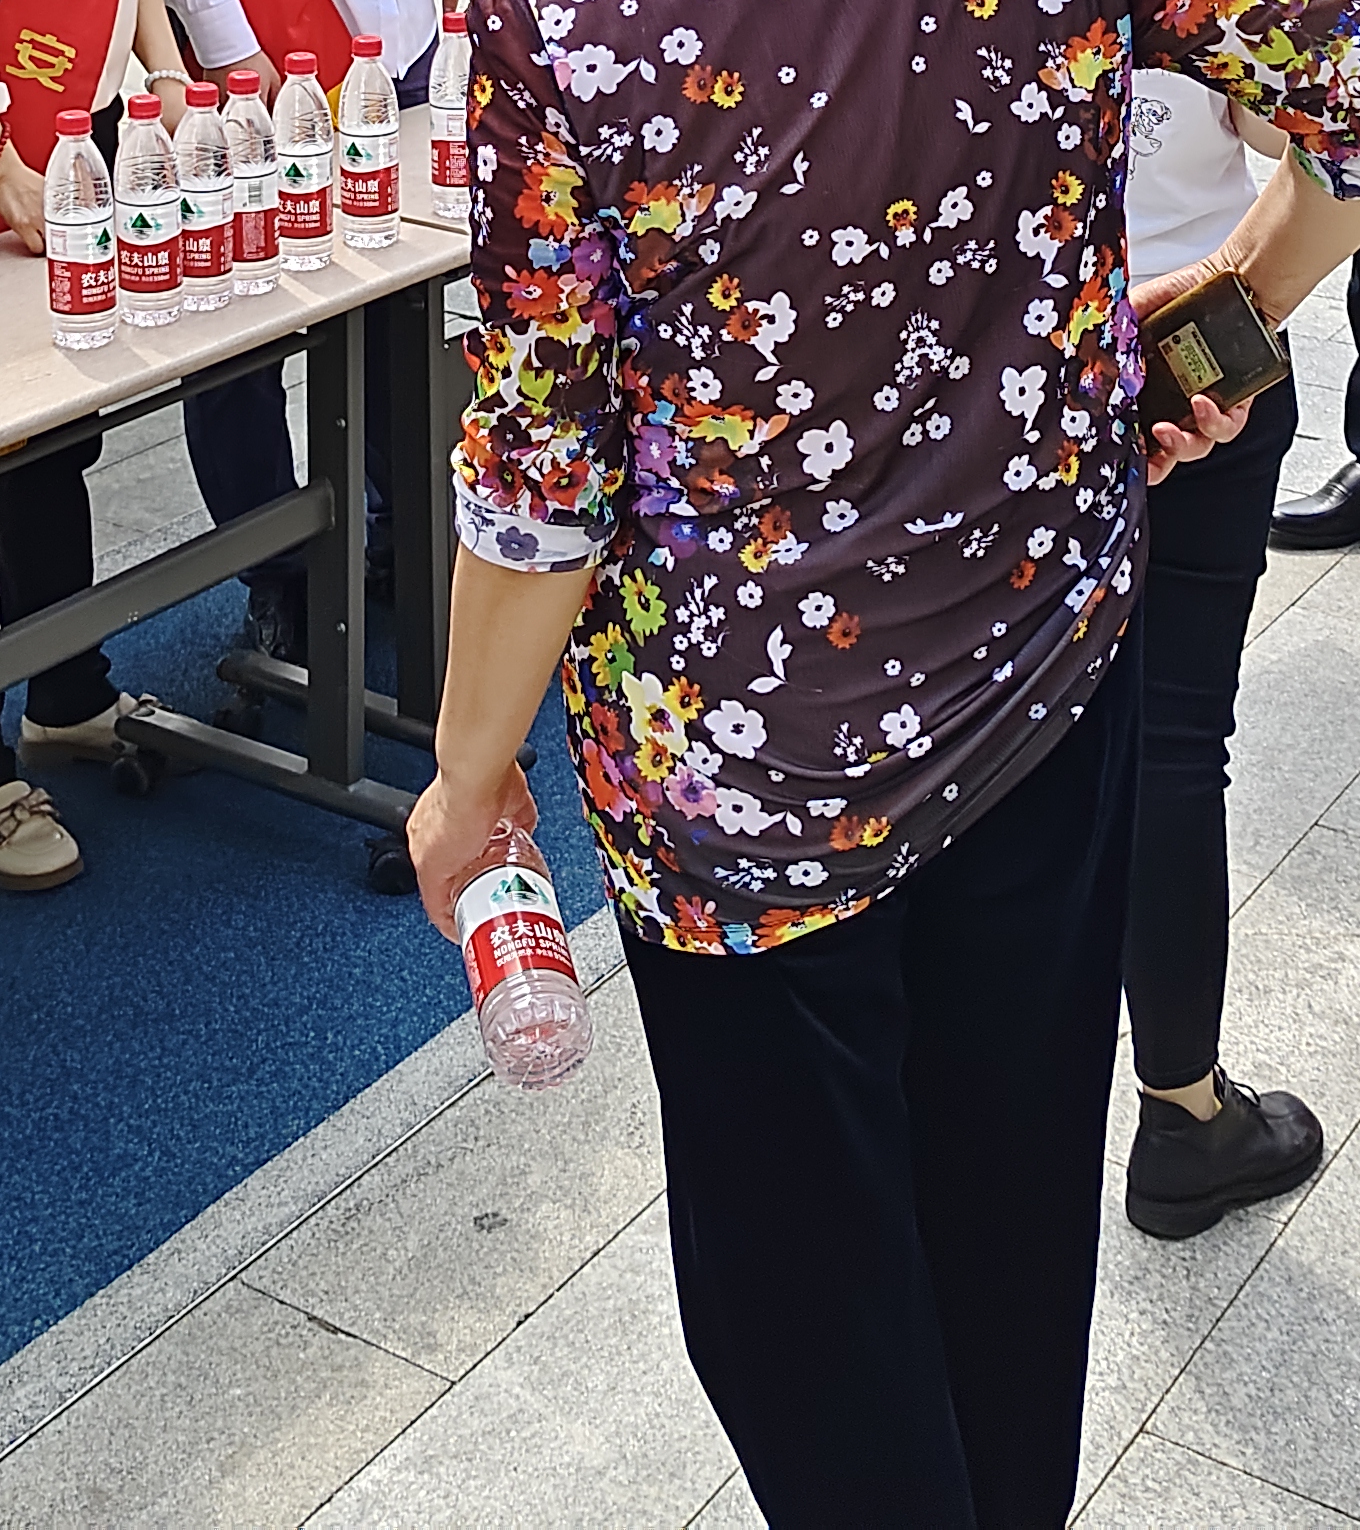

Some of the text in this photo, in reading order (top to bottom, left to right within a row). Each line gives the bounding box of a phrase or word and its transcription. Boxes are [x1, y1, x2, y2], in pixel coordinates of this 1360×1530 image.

[120, 250, 170, 267] 农夫山泉
[490, 919, 568, 950] 农夫山泉
[494, 938, 536, 959] NONGFU
